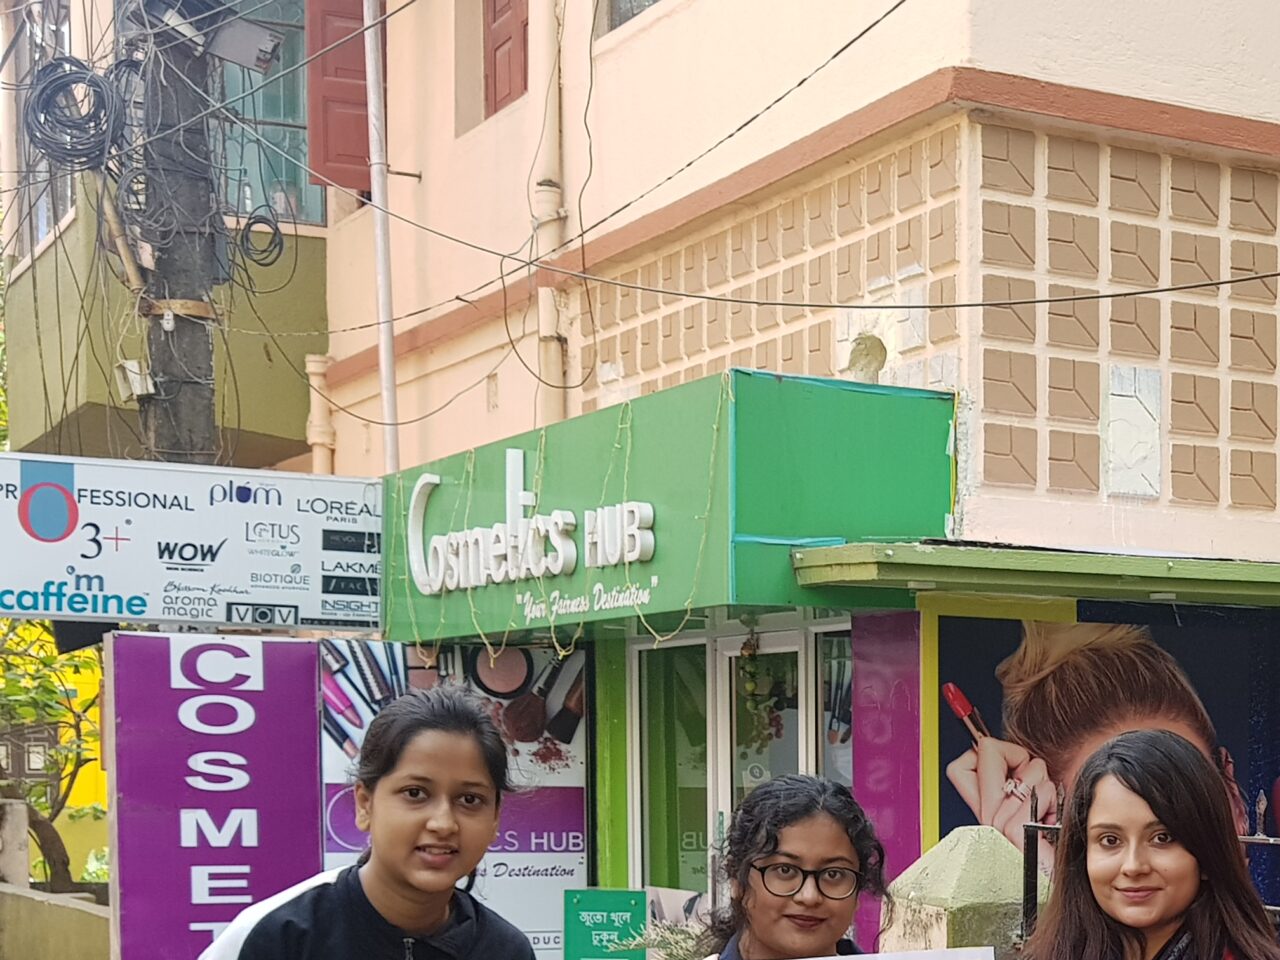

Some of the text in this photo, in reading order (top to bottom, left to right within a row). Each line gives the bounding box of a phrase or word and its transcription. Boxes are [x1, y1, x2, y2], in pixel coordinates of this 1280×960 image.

[408, 448, 656, 597] Cosmetics HUB
[157, 538, 228, 562] WOW
[250, 573, 310, 585] BIOTIQUE
[0, 581, 147, 615] caffeine
[163, 595, 217, 607] aroma
[162, 606, 214, 618] magic
[530, 832, 584, 851] HUB
[493, 862, 575, 878] Destination
